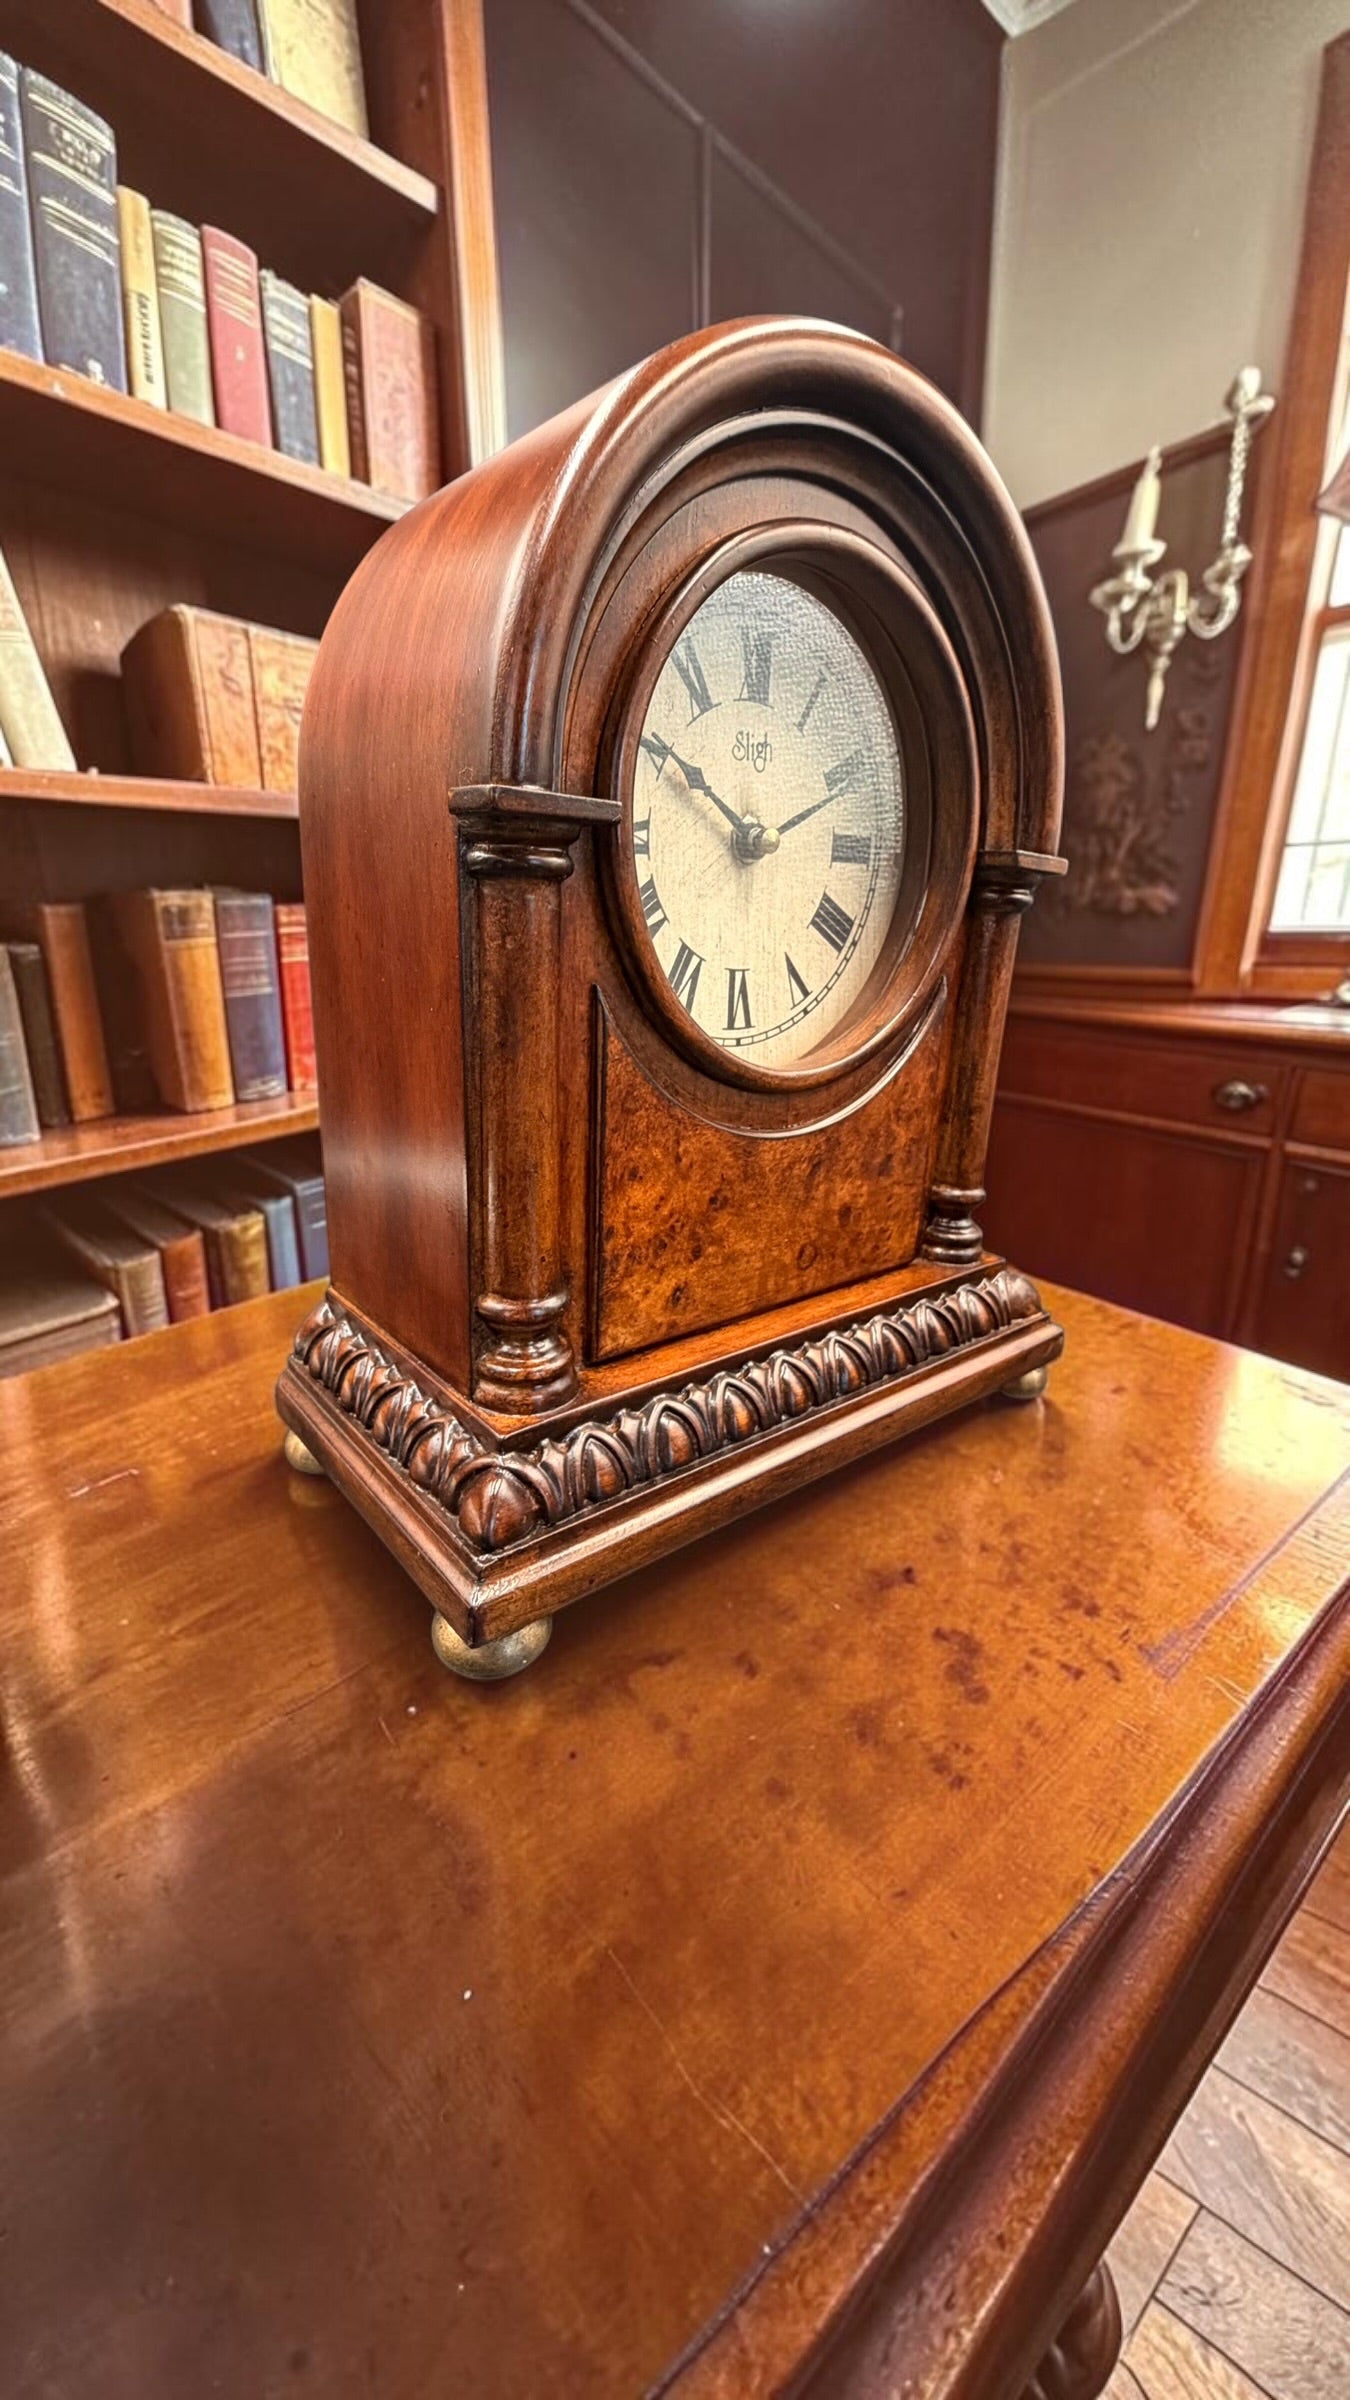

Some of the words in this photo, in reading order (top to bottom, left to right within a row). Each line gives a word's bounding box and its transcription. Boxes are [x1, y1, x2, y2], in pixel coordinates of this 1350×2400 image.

[670, 634, 722, 727] XI
[731, 731, 773, 773] Sligh
[806, 886, 857, 959] IIII
[722, 967, 756, 1030] VI
[784, 951, 813, 1011] V
